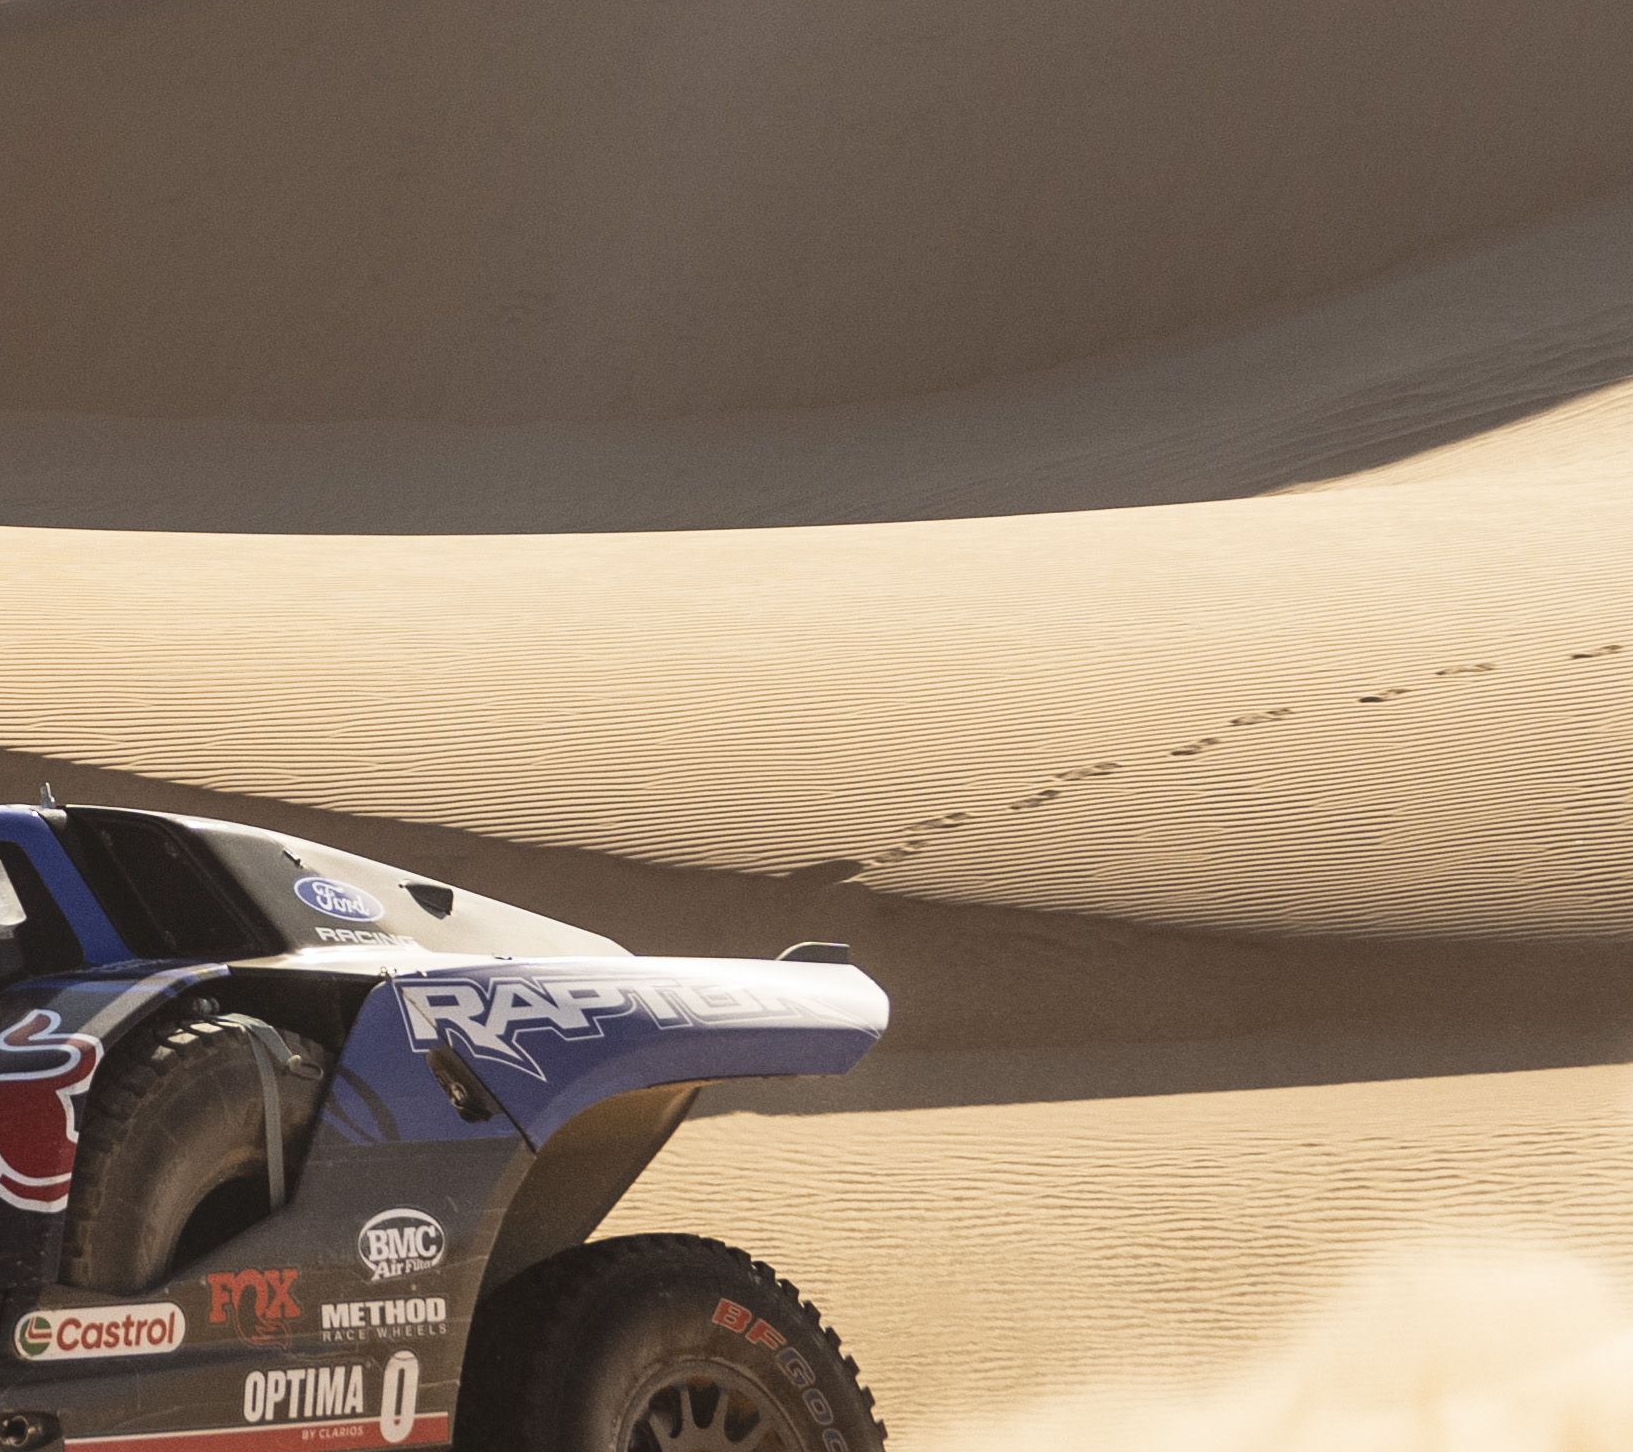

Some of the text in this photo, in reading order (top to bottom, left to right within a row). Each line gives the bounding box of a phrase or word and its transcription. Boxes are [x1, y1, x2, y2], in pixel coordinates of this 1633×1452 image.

[312, 880, 370, 916] Ford
[315, 926, 414, 946] RACING
[391, 978, 881, 1080] RAPTOR
[367, 1225, 437, 1261] BMC
[371, 1258, 403, 1282] Air
[207, 1267, 302, 1340] FOX
[321, 1298, 446, 1329] METHOD
[56, 1311, 175, 1350] Castrol
[322, 1323, 448, 1343] RACE WHEELS
[243, 1364, 364, 1423] OPTIMA
[301, 1424, 364, 1441] BY CLARIOS
